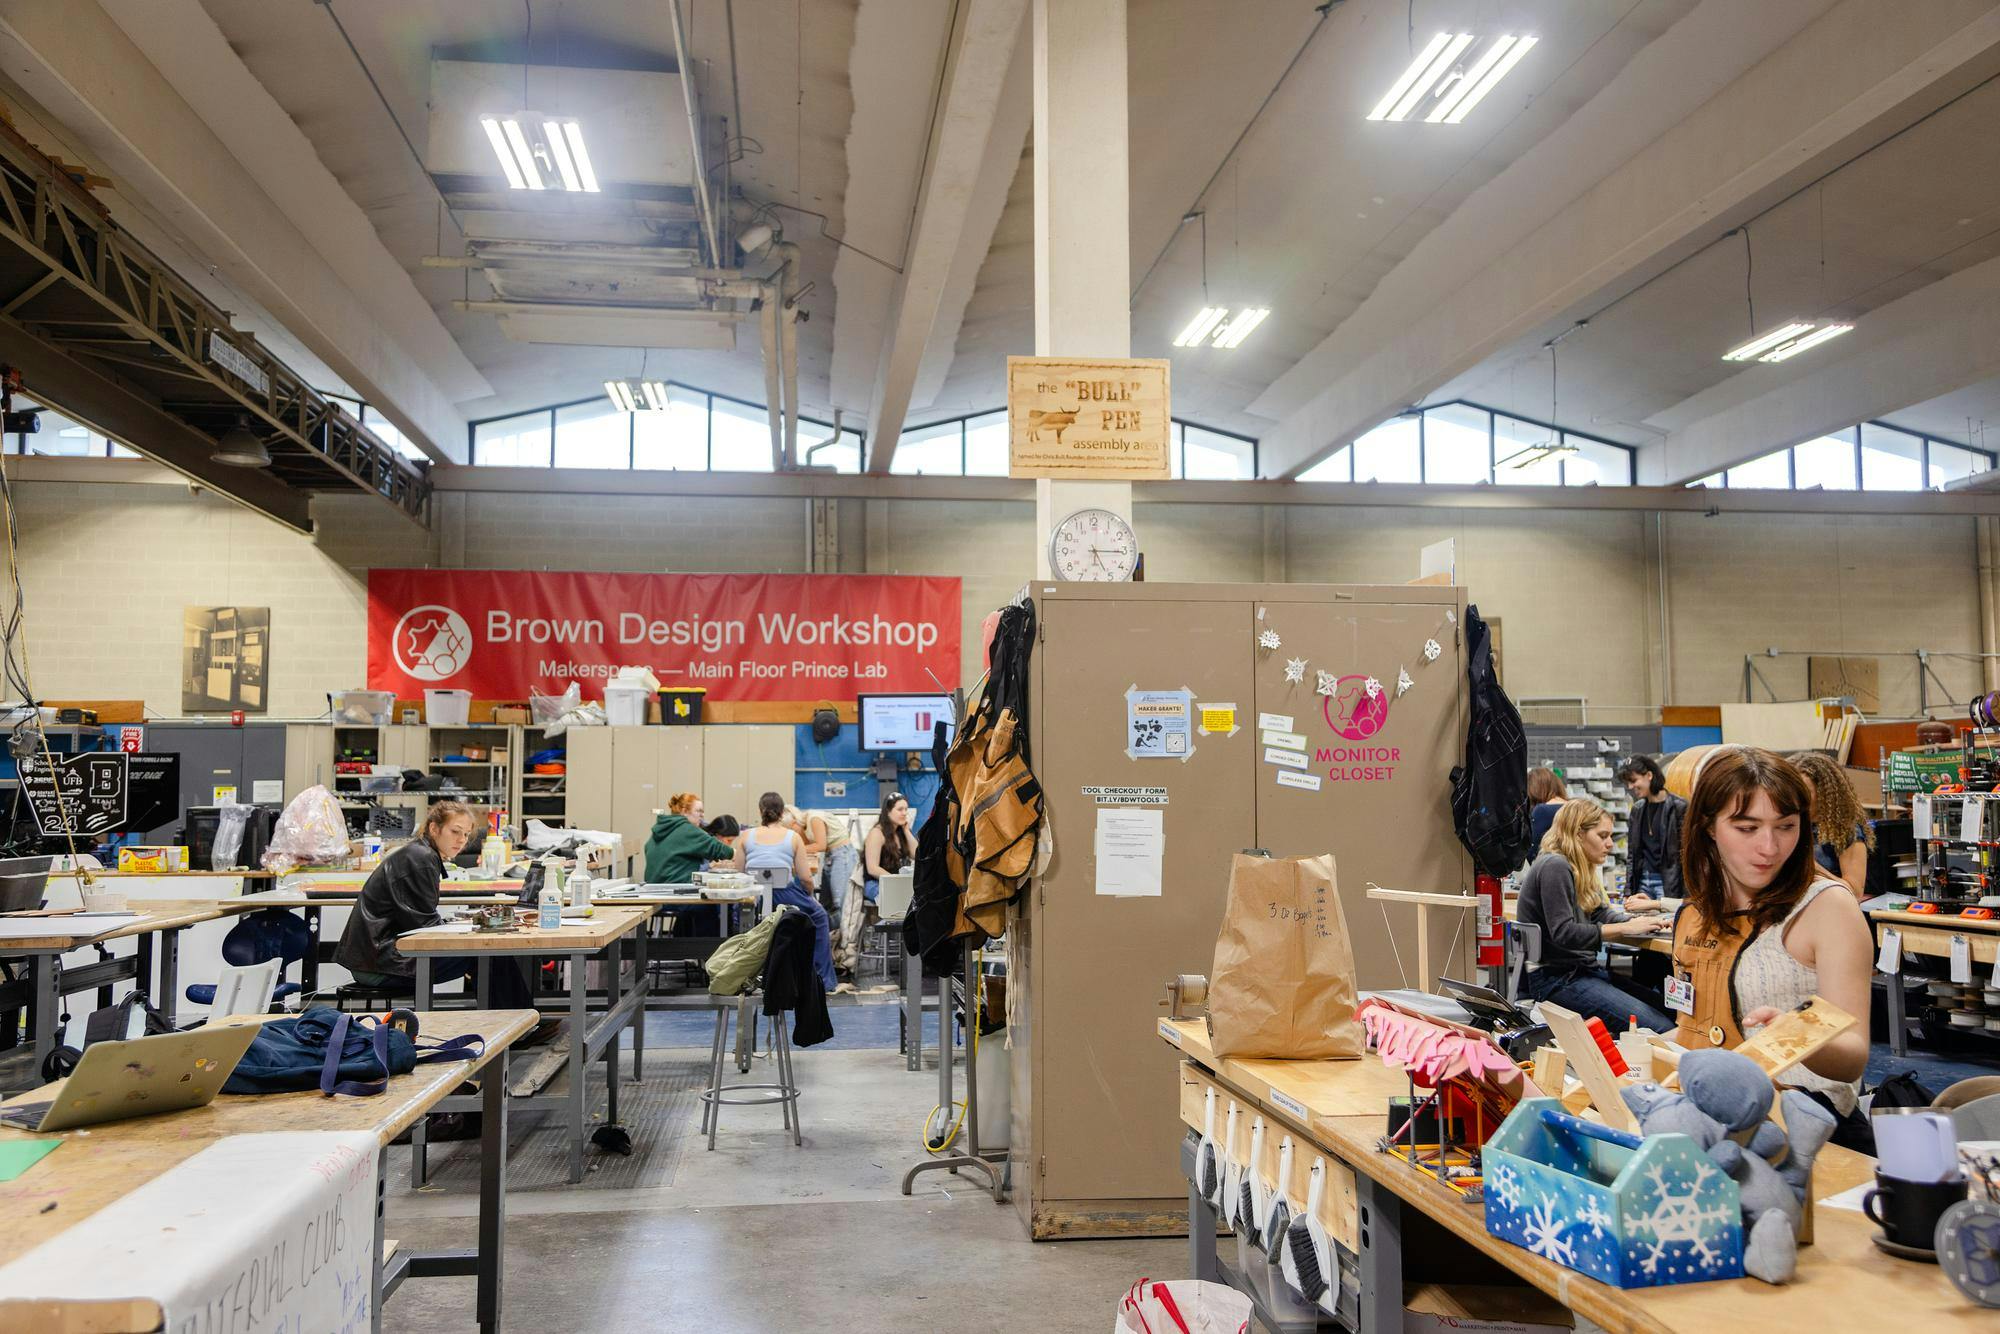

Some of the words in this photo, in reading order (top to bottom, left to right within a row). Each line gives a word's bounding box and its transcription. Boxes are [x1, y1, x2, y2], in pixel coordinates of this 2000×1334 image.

[1037, 381, 1057, 394] the
[1100, 409, 1142, 432] PEN
[1073, 438, 1130, 454] assembly
[1089, 517, 1098, 526] 12
[1064, 533, 1073, 541] 10
[1116, 531, 1123, 540] 2
[1061, 547, 1069, 556] 9
[1121, 546, 1128, 555] 3
[1066, 562, 1073, 571] 8
[1118, 561, 1124, 570] 4
[1107, 572, 1114, 581] 5
[487, 611, 603, 645] Brown
[619, 613, 746, 654] Design
[758, 614, 939, 653] Workshop
[539, 660, 654, 680] Makersp
[689, 661, 734, 679] Main
[739, 661, 787, 679] Floor
[791, 662, 848, 680] Prince
[853, 663, 888, 680] Lab
[1315, 747, 1401, 762] MONITOR
[63, 776, 83, 786] UFB
[1329, 767, 1395, 781] CLOSET
[44, 815, 78, 833] 24
[1268, 902, 1277, 918] 3
[301, 1193, 346, 1288] CLUB
